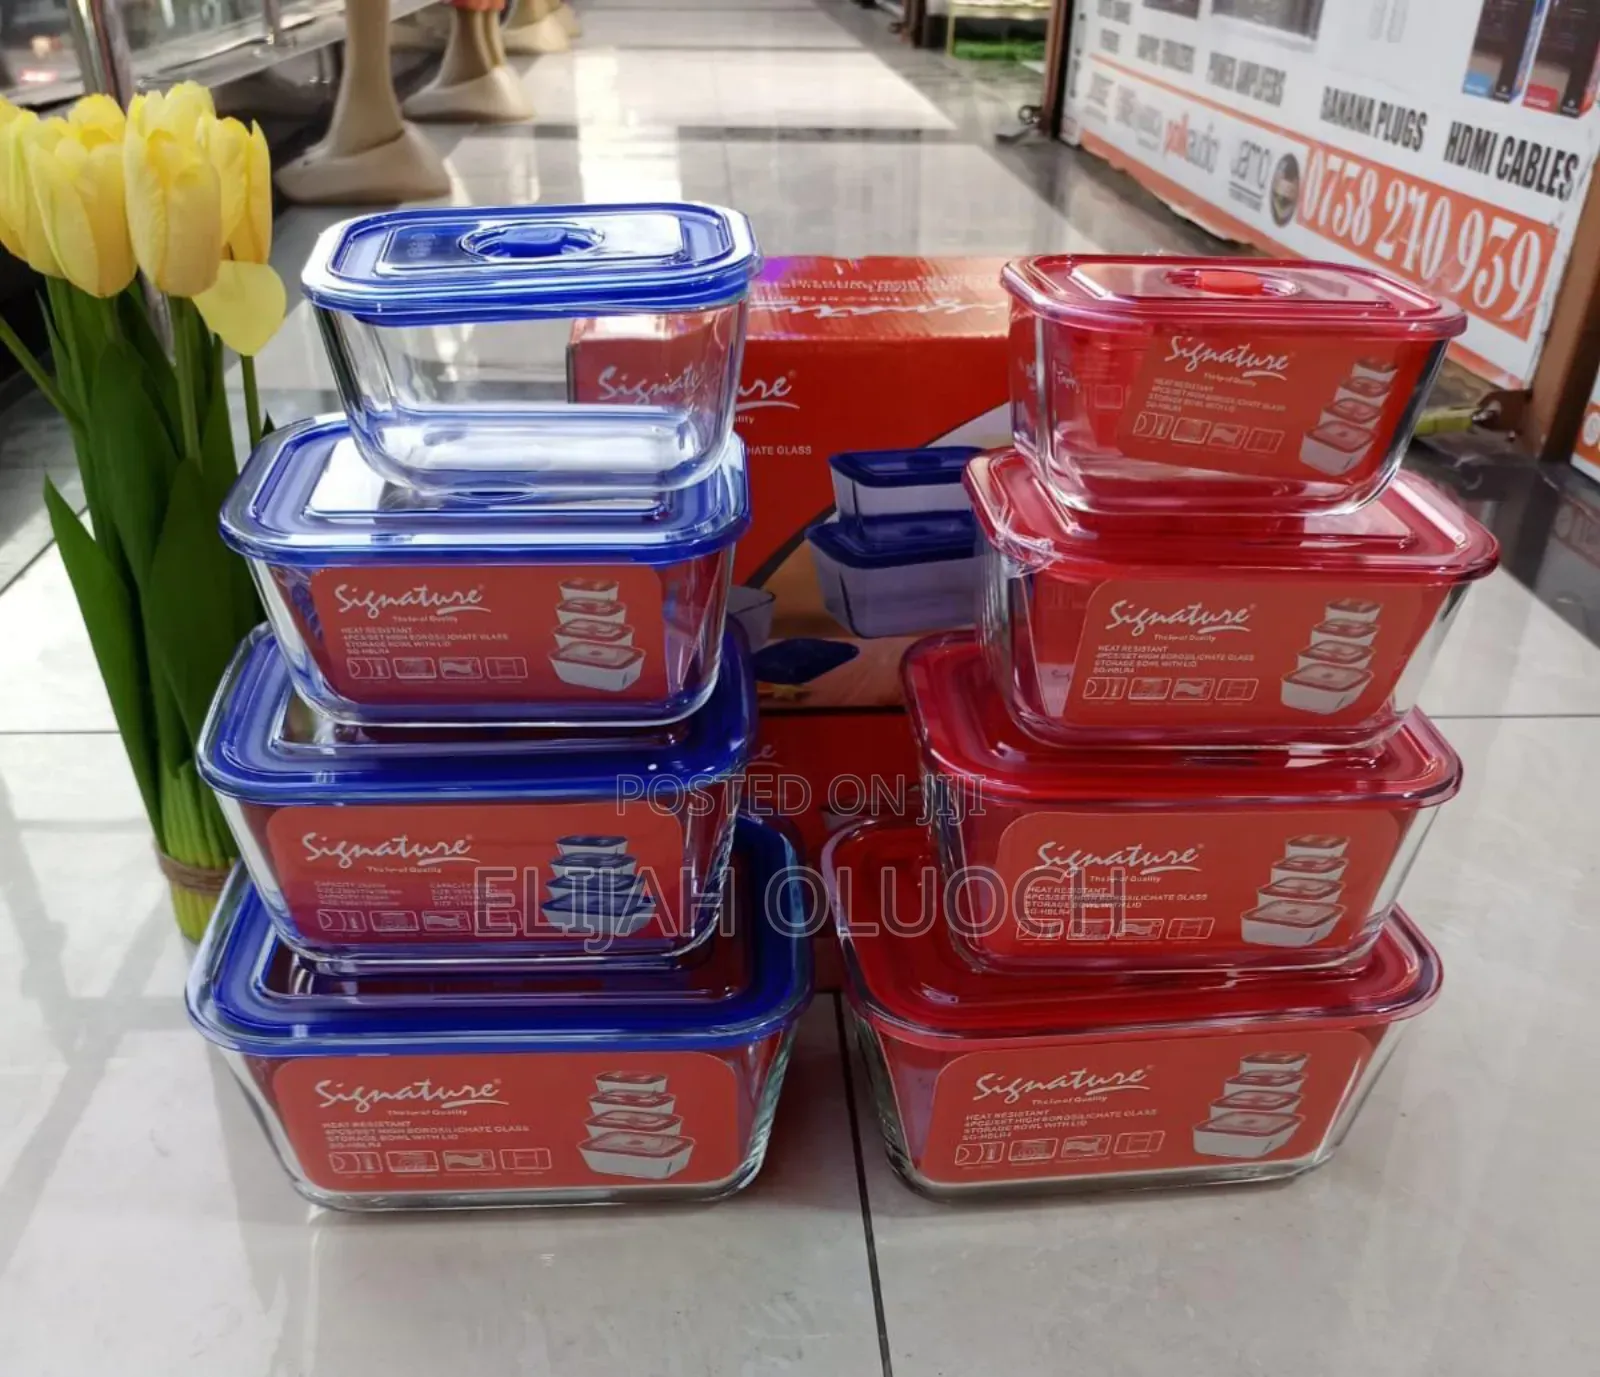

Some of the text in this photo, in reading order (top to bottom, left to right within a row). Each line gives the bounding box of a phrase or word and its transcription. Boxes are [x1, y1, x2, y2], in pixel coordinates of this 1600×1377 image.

[1319, 85, 1428, 152] BANANA PLUGS
[1444, 121, 1580, 201] HDMI CABLES
[1301, 147, 1541, 322] 0738 240 939
[1164, 336, 1289, 373] Signature
[776, 445, 812, 456] GLASS
[334, 582, 482, 619] Signature
[1104, 600, 1250, 637] Signature
[1120, 645, 1168, 653] RESISTANT
[302, 832, 472, 869] Signature
[1034, 841, 1199, 879] Signature
[1129, 875, 1162, 884] Quality
[1026, 886, 1053, 894] HEAT
[1176, 893, 1208, 901] GLASS
[973, 1067, 1148, 1105] Signature
[314, 1076, 500, 1113] Signature
[1074, 1096, 1108, 1104] Quality
[431, 1109, 468, 1117] Quality
[966, 1110, 1050, 1121] HEAT RESISTANT
[1014, 1116, 1041, 1125] HIGH
[1123, 1109, 1157, 1117] GLASS
[351, 1120, 412, 1129] RESISTANT
[494, 1125, 530, 1133] GLASS
[963, 1126, 1012, 1135] STORAGE
[1013, 1123, 1042, 1131] BOWL
[1043, 1121, 1069, 1129] WITH
[379, 1134, 412, 1142] BOWL
[412, 1134, 440, 1142] WITH
[441, 1133, 459, 1141] LID
